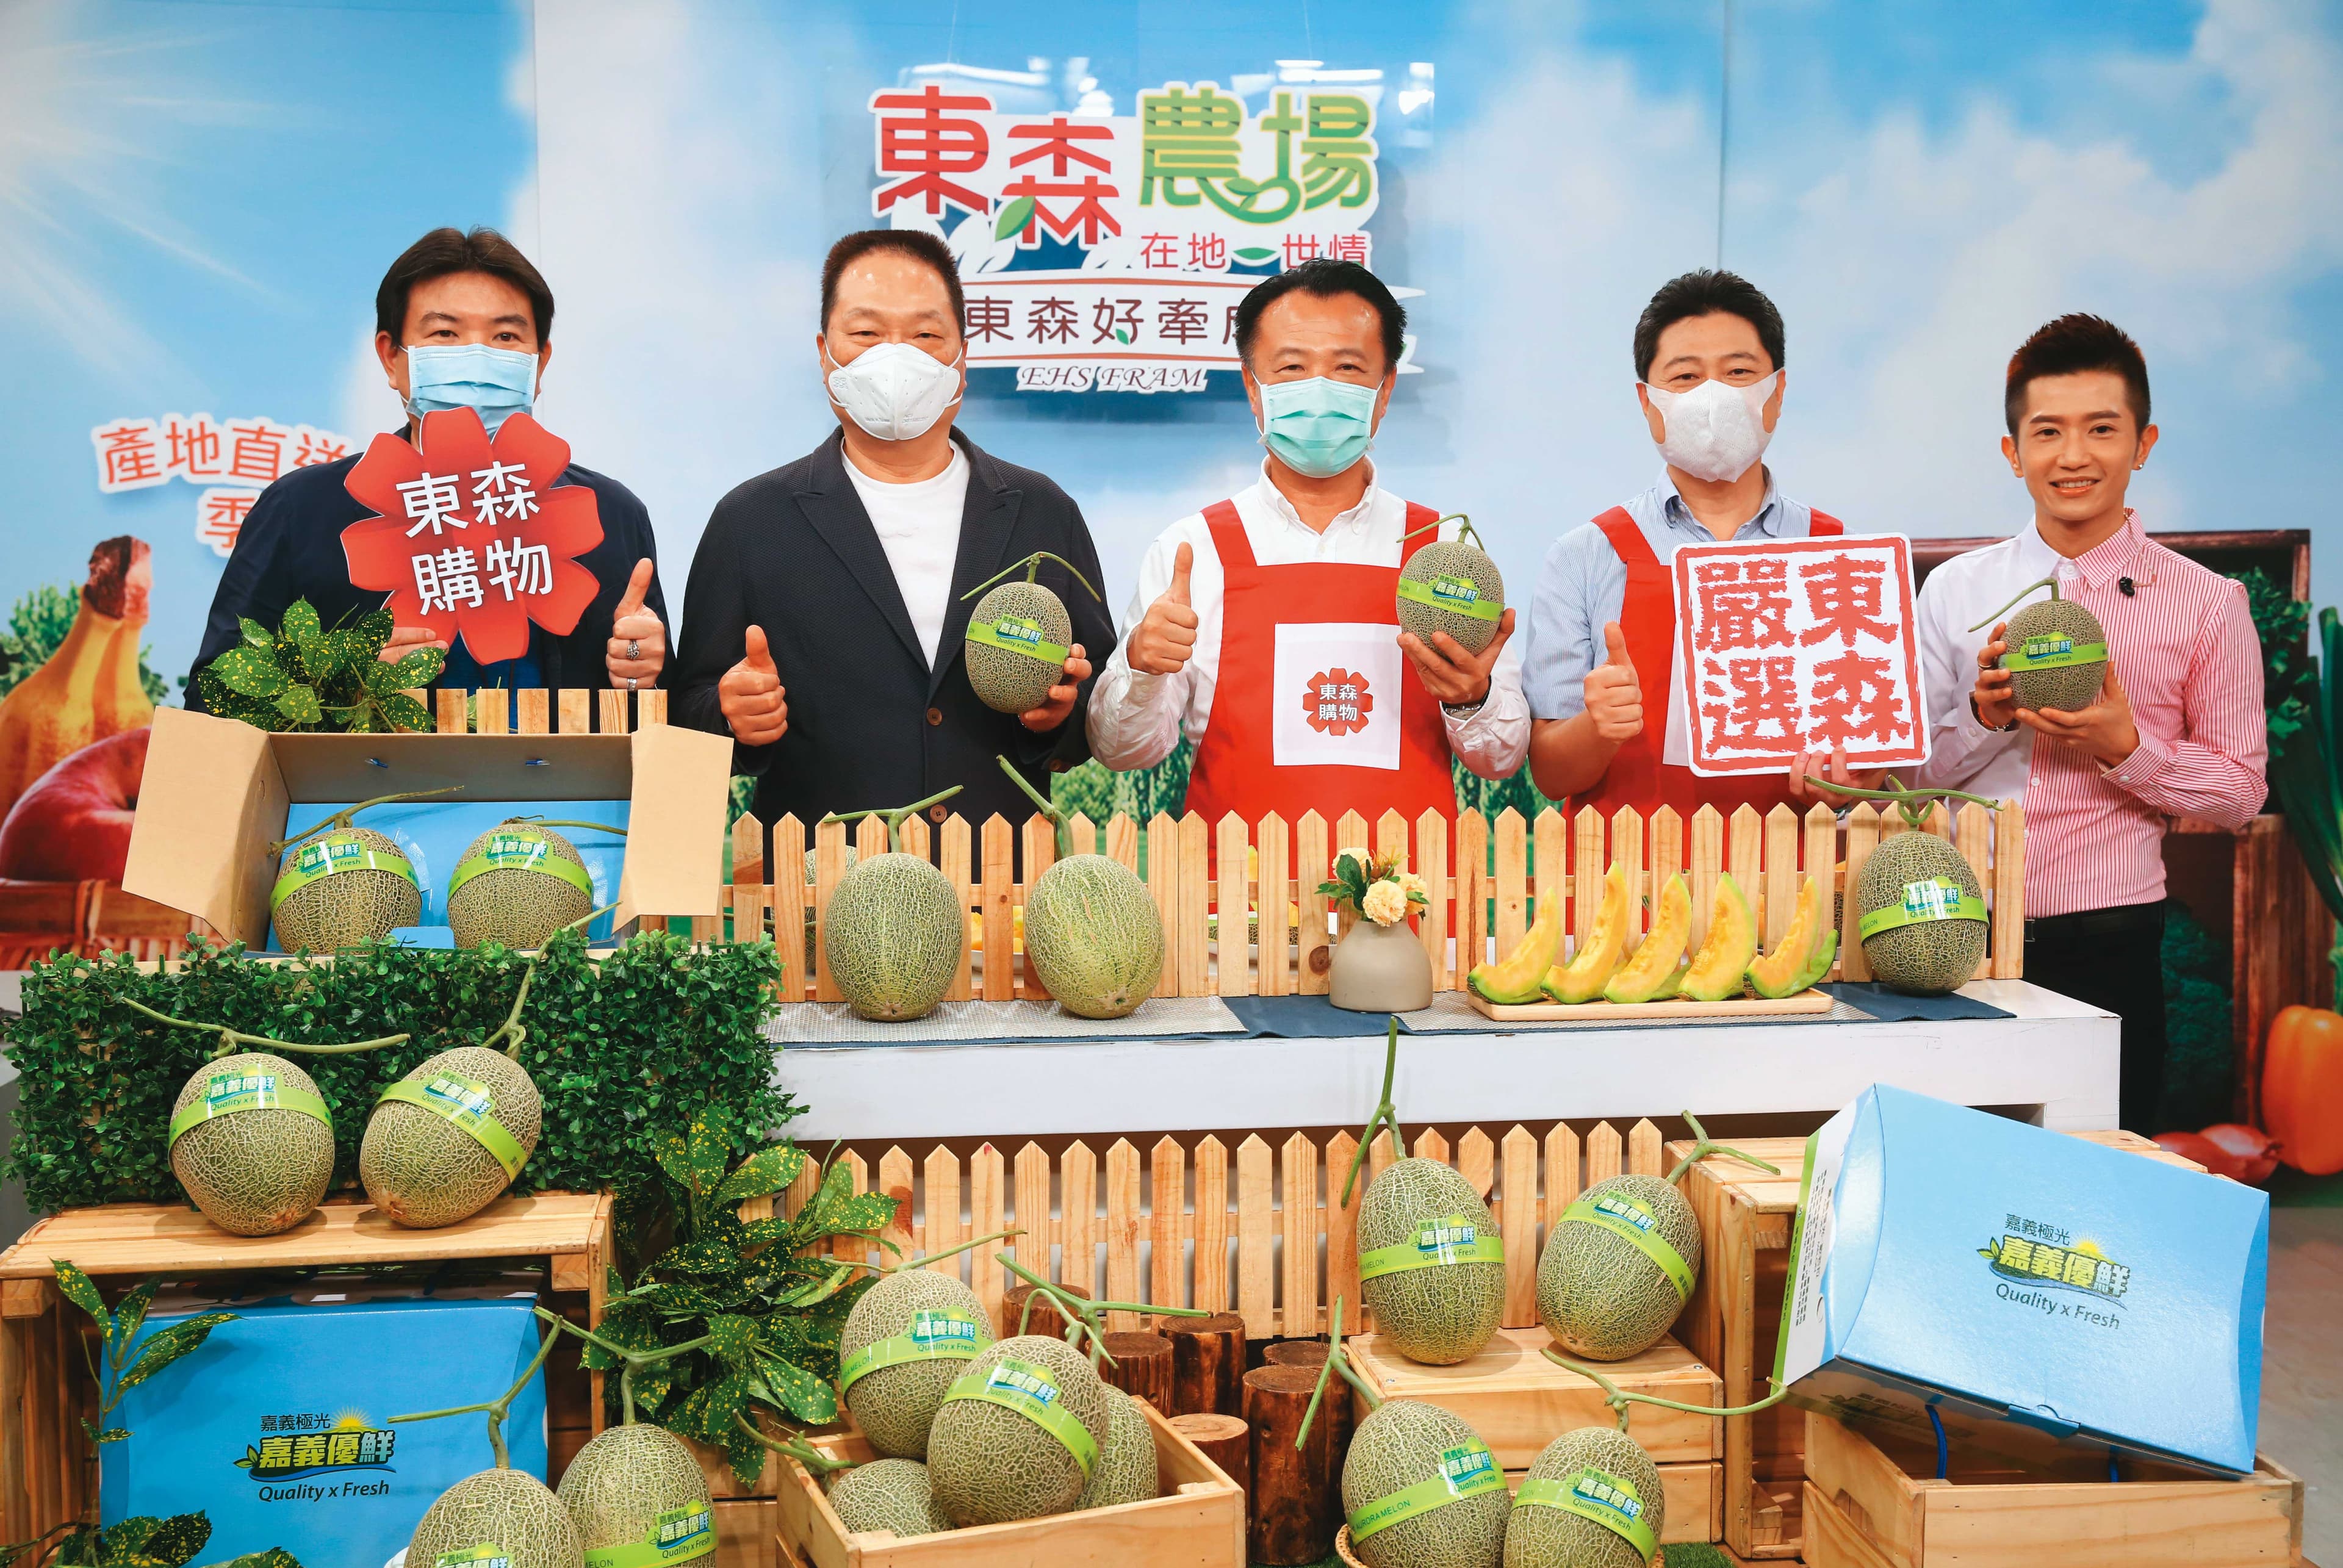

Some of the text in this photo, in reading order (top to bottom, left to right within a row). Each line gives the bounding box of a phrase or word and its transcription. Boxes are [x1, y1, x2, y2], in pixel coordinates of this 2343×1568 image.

[874, 85, 1372, 245] 東森農場
[395, 461, 541, 538] 東森
[411, 537, 553, 616] 購物
[1432, 595, 1453, 606] Quality
[1456, 602, 1472, 611] Fresh
[996, 637, 1017, 647] Quality
[1020, 643, 1036, 652] Fresh
[1798, 553, 1911, 747] 東森
[1693, 559, 1807, 757] 嚴選
[1319, 683, 1358, 701] 東森
[1319, 703, 1358, 722] 購物
[211, 1098, 242, 1111] Quality
[422, 1093, 448, 1110] Quality
[1592, 1213, 1618, 1226] Quality
[1622, 1224, 1642, 1240] Fresh
[2004, 1213, 2071, 1246] 嘉義極光
[1998, 1234, 2130, 1298] 嘉義優鮮
[1996, 1283, 2120, 1329] Quality x Fresh
[957, 1343, 976, 1352] Fresh
[261, 1412, 331, 1432] 嘉義極光
[259, 1430, 395, 1469] 嘉義優鮮
[259, 1480, 389, 1503] Quality x Fresh
[1380, 1499, 1411, 1518] MELON
[1572, 1498, 1605, 1516] Quality
[1611, 1512, 1632, 1531] Fresh
[662, 1545, 689, 1559] Quality
[696, 1536, 710, 1548] Fresh
